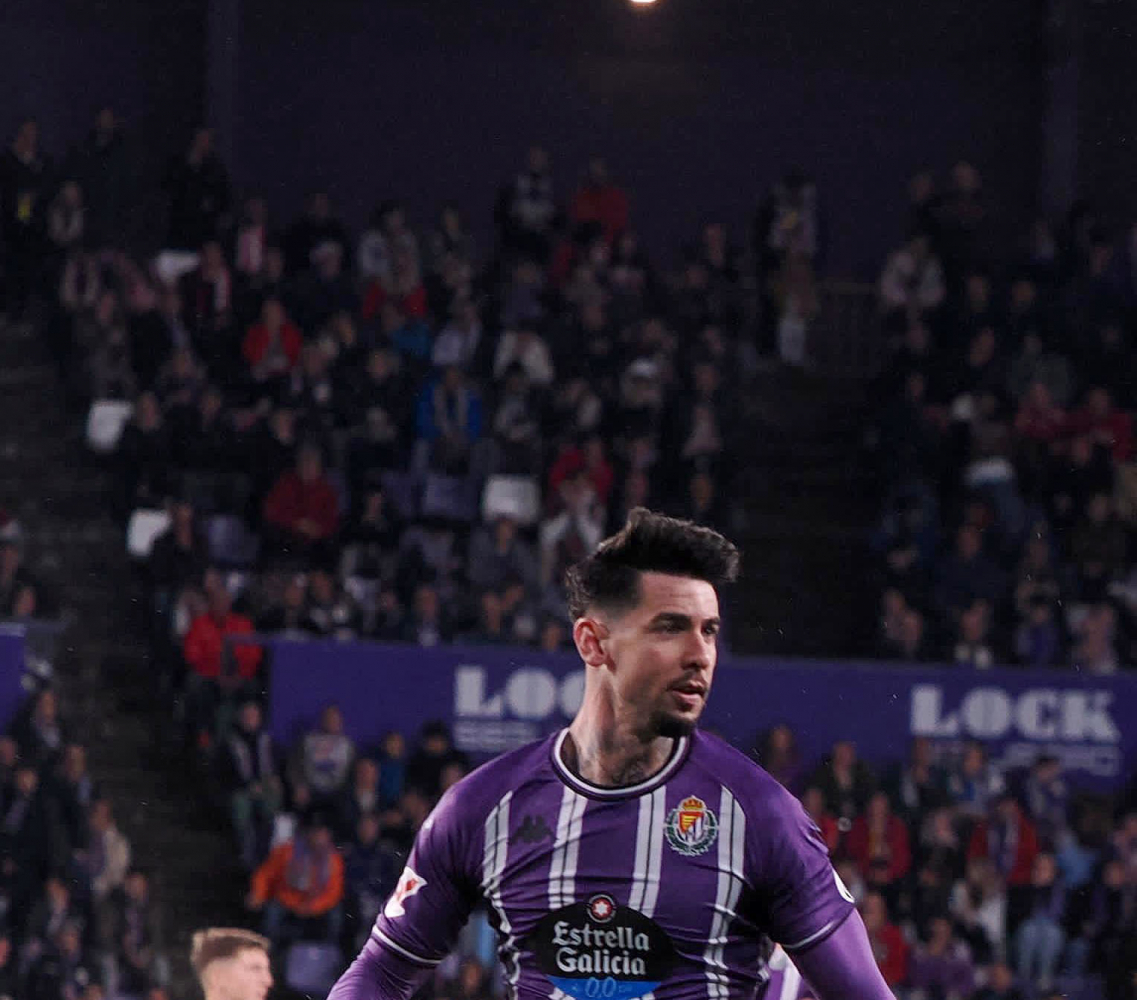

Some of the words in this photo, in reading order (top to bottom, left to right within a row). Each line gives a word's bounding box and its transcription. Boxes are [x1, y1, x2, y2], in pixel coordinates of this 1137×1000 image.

[455, 664, 587, 719] LOC
[910, 683, 1121, 742] LOCK
[552, 920, 650, 951] Estrella
[556, 946, 646, 975] Galicia
